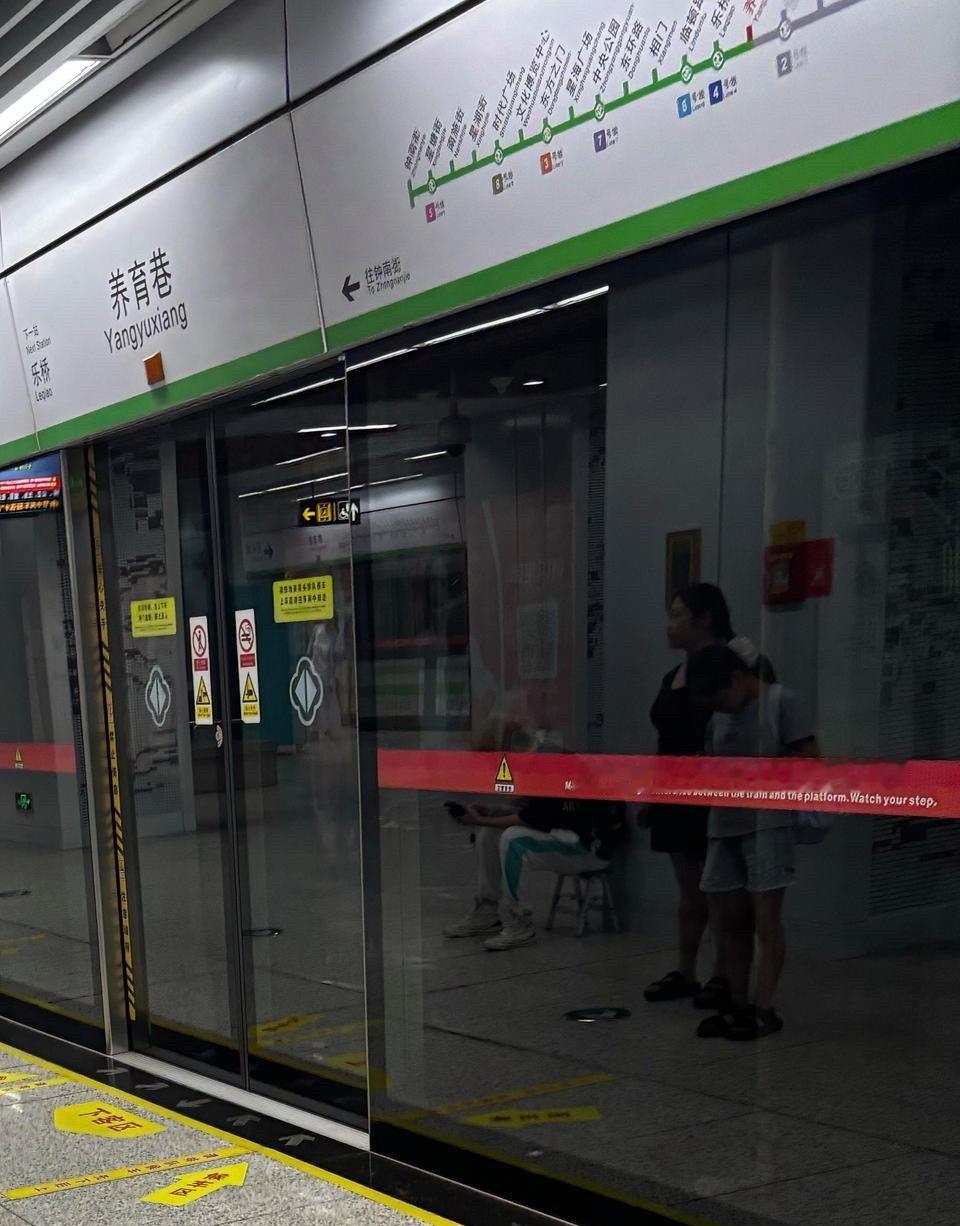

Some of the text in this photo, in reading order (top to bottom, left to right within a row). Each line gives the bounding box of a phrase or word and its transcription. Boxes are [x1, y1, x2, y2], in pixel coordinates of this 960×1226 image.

[566, 30, 593, 97] 星海广场
[593, 18, 620, 85] 中央公园
[620, 20, 643, 72] 东环路
[649, 20, 667, 57] 相门
[492, 70, 516, 132] 时代广场
[516, 29, 550, 122] 文化博览中心
[540, 44, 566, 109] 东方之门
[108, 247, 172, 321] 养育巷
[365, 256, 402, 285] 往钟南街
[22, 323, 39, 340] 下一站
[103, 301, 188, 354] Yangyuxiang
[31, 357, 51, 387] 乐桥
[768, 790, 786, 800] and
[787, 790, 803, 801] the
[850, 791, 882, 804] Watch
[883, 795, 907, 806] your
[78, 1107, 144, 1133] 下客区
